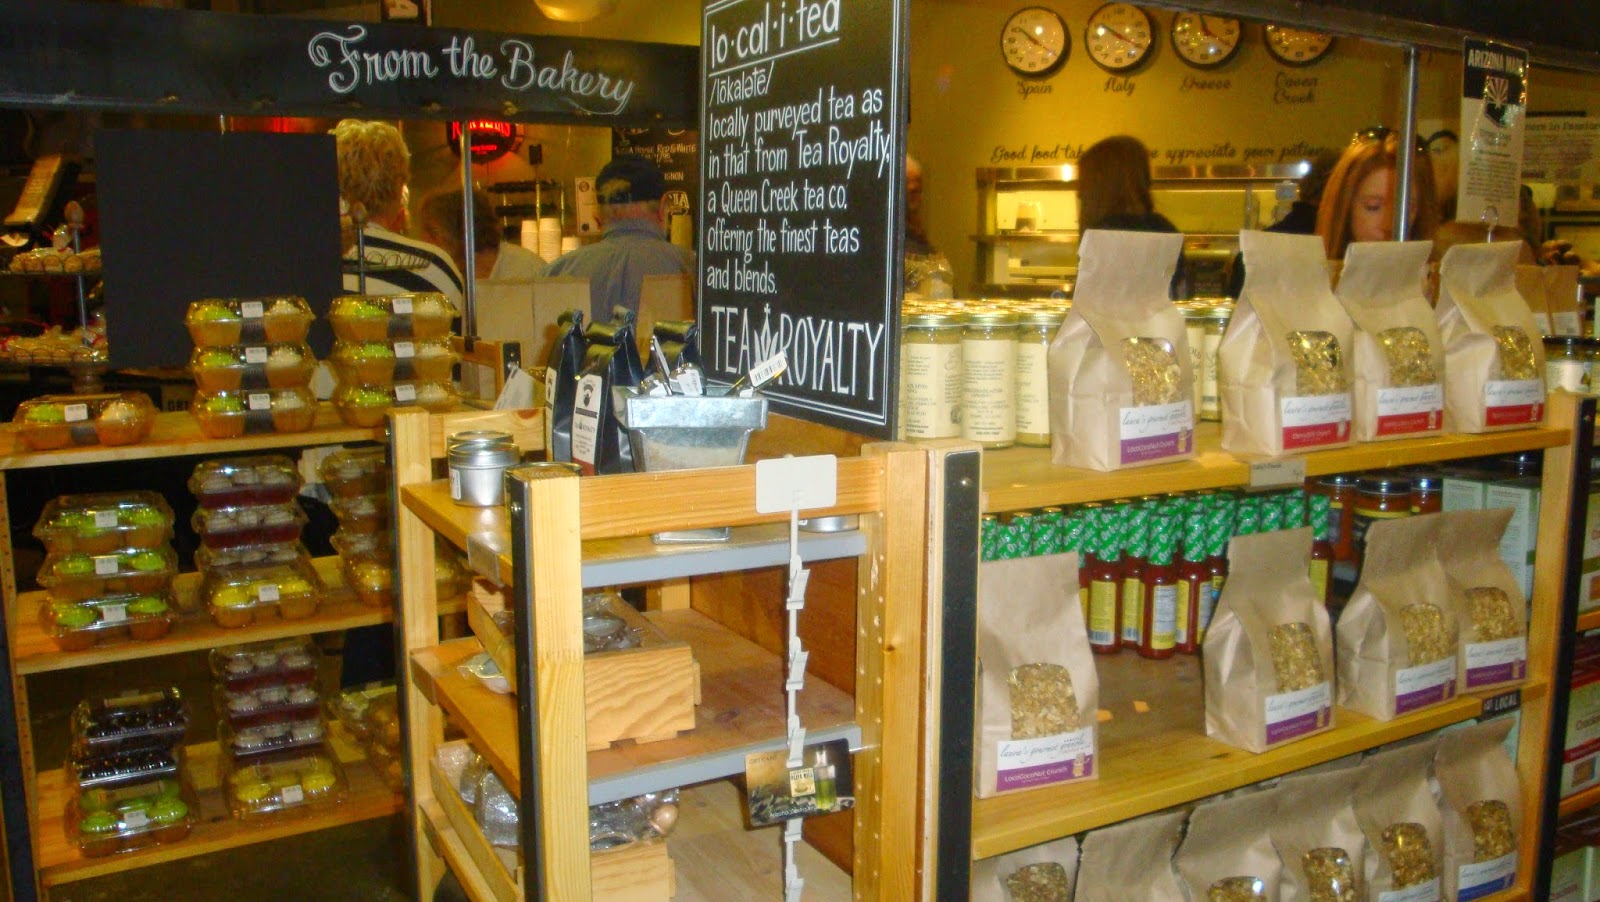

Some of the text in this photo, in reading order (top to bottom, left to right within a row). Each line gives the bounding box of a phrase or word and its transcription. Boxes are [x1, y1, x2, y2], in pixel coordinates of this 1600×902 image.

[309, 25, 635, 116] From the Bakery
[1016, 80, 1054, 100] Spain
[1103, 76, 1136, 97] Italy
[709, 85, 883, 147] locally purveyed tea as
[708, 119, 891, 180] in that from Tea Royalty,
[990, 143, 1028, 164] Good
[1030, 143, 1061, 164] food
[707, 189, 717, 214] a
[721, 181, 758, 217] Queen
[761, 178, 799, 213] Creek
[803, 178, 825, 211] tea
[828, 184, 848, 211] co.
[707, 217, 860, 264] offering the finest teas
[706, 257, 778, 295] and blends.
[711, 305, 750, 375] TEA
[777, 312, 885, 401] ROYALTY
[1046, 765, 1069, 776] Crunch
